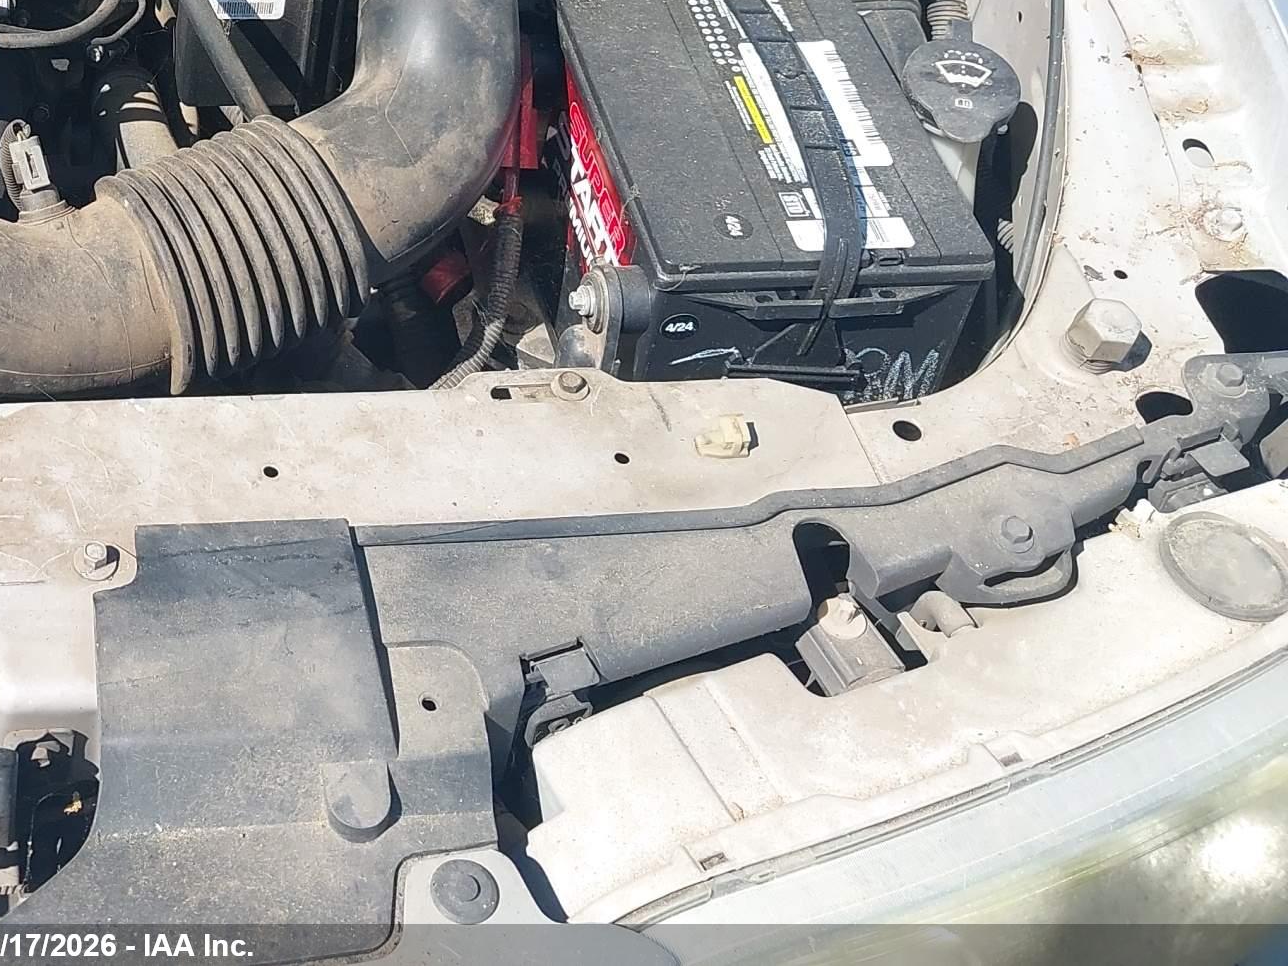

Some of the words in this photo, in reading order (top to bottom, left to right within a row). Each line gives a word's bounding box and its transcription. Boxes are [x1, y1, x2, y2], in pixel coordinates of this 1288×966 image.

[570, 102, 625, 260] SUPER
[725, 216, 744, 236] 4/24
[665, 321, 694, 332] 4/24
